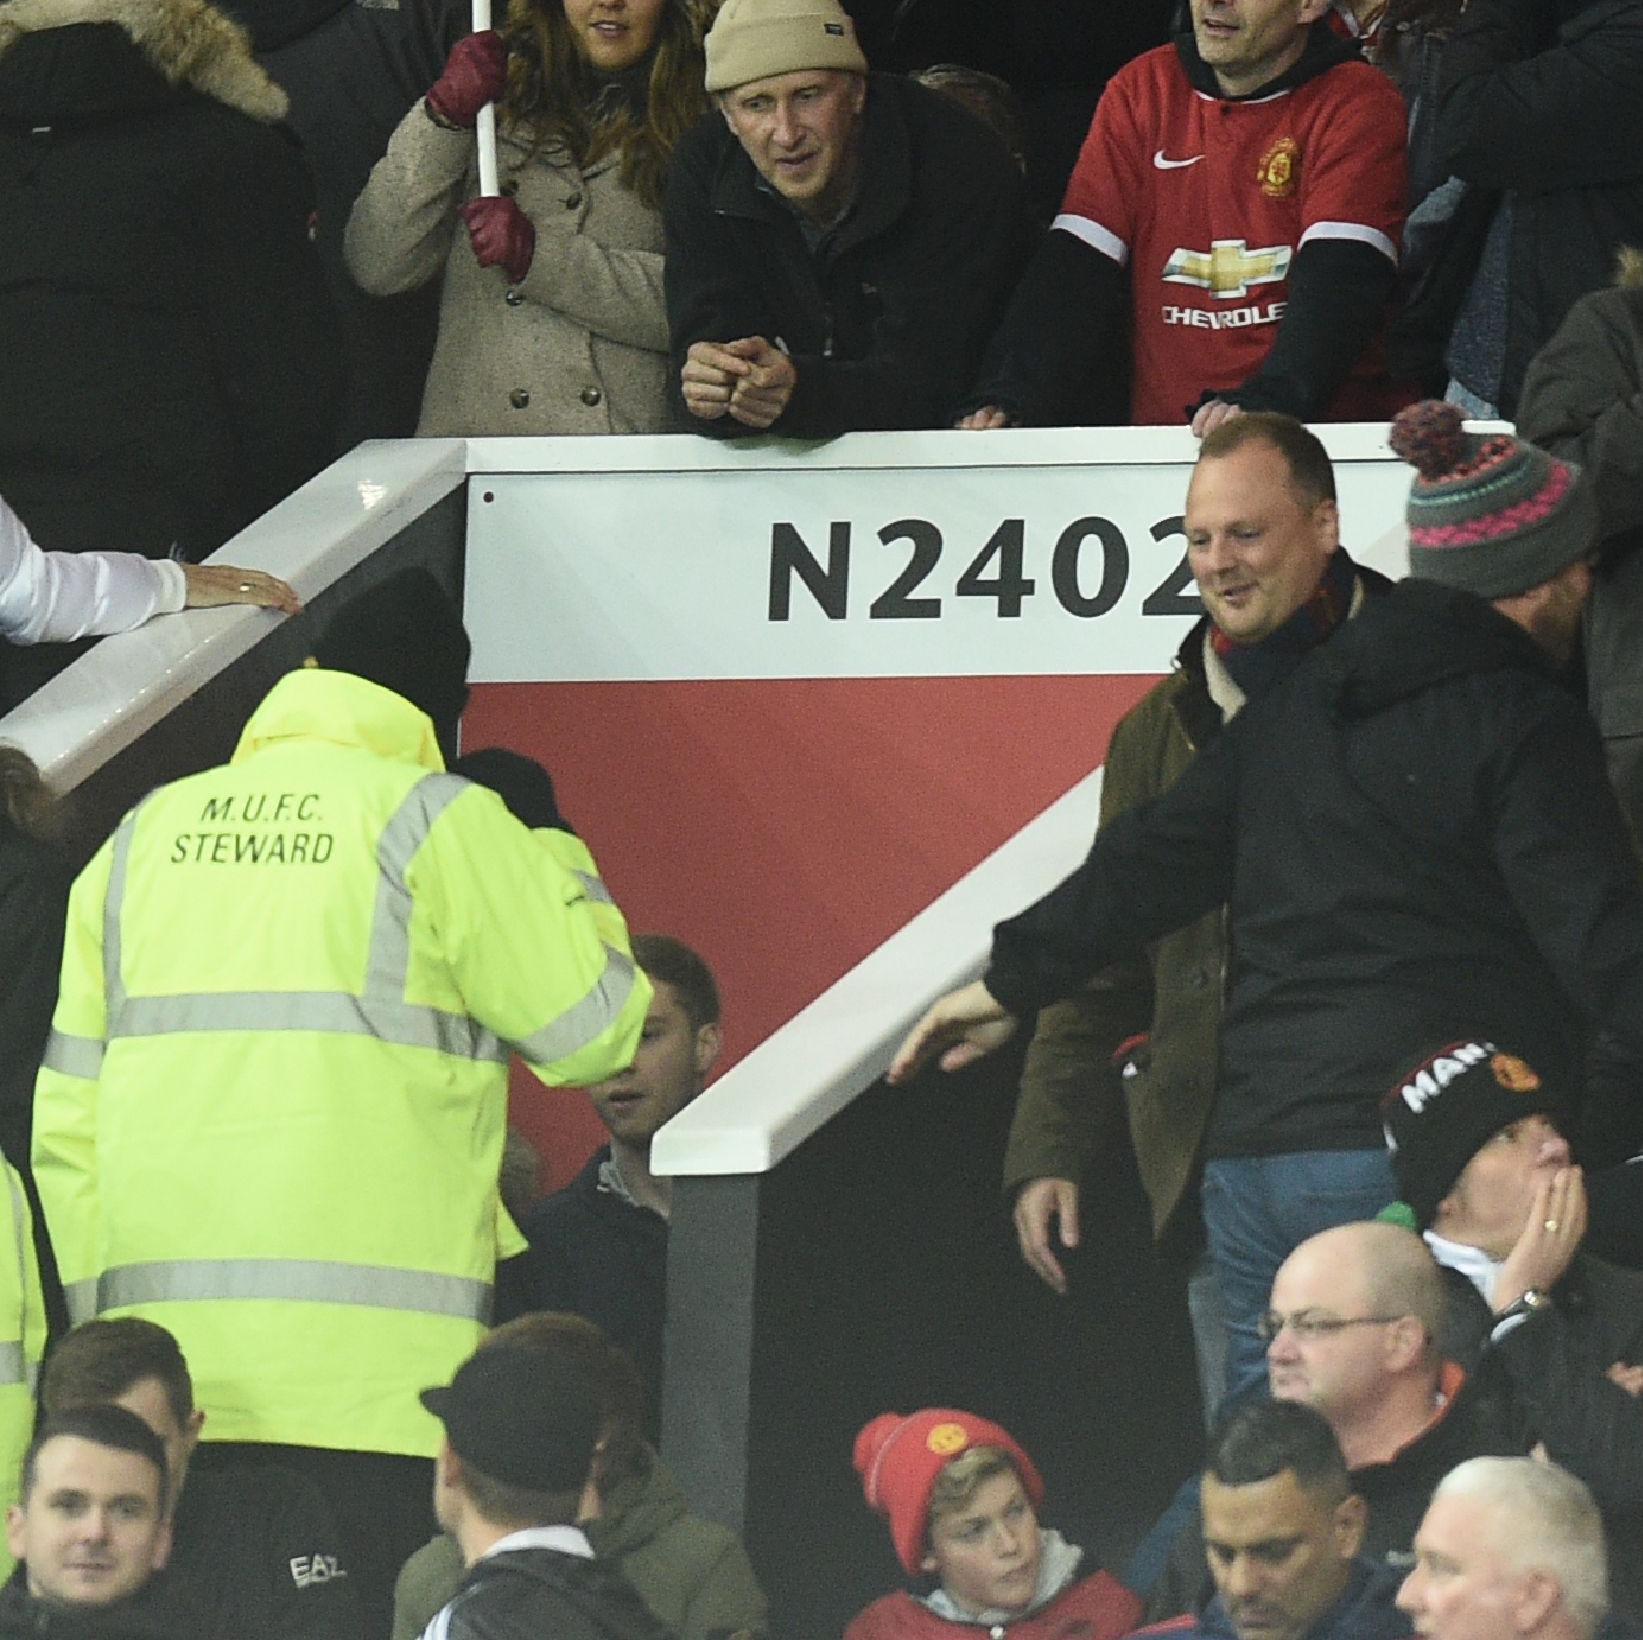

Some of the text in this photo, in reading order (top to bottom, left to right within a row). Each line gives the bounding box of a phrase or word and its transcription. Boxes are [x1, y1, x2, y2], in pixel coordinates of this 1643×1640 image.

[1161, 301, 1289, 331] CHEVROLE
[768, 515, 1202, 622] N2402
[201, 793, 323, 822] M.U.F.C.
[170, 833, 334, 864] STEWARD
